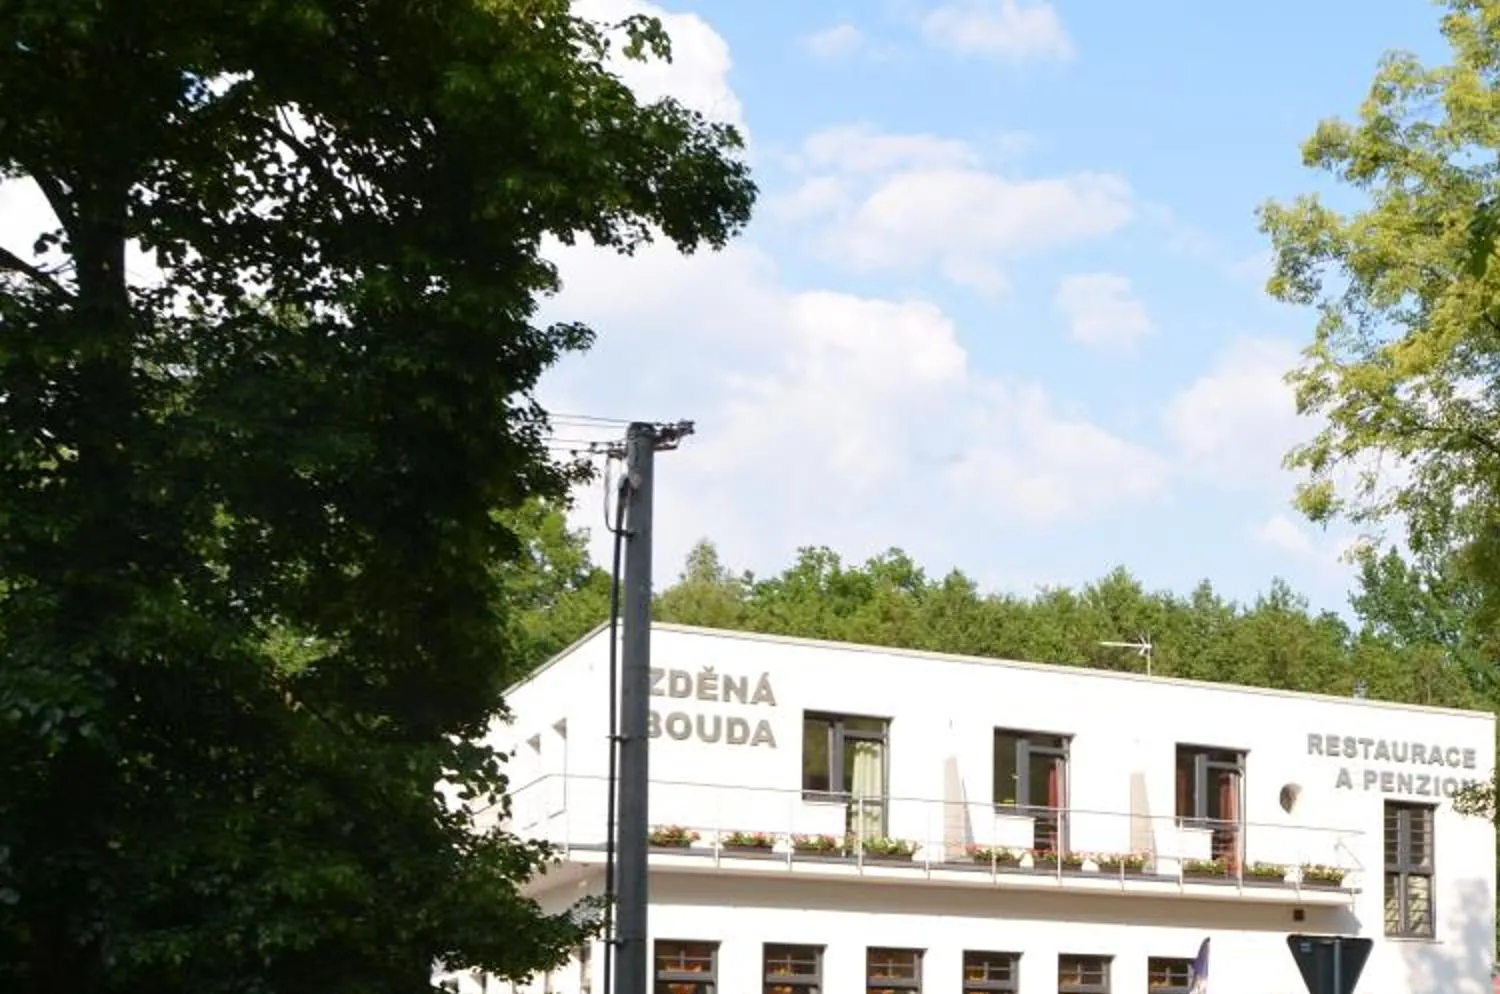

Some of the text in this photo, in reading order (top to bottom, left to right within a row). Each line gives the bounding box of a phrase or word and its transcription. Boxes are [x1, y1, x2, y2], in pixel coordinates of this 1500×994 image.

[650, 665, 777, 706] ZDĚNÁ
[648, 710, 777, 748] BOUDA
[1307, 733, 1476, 769] RESTAURACE
[1336, 768, 1353, 790] A
